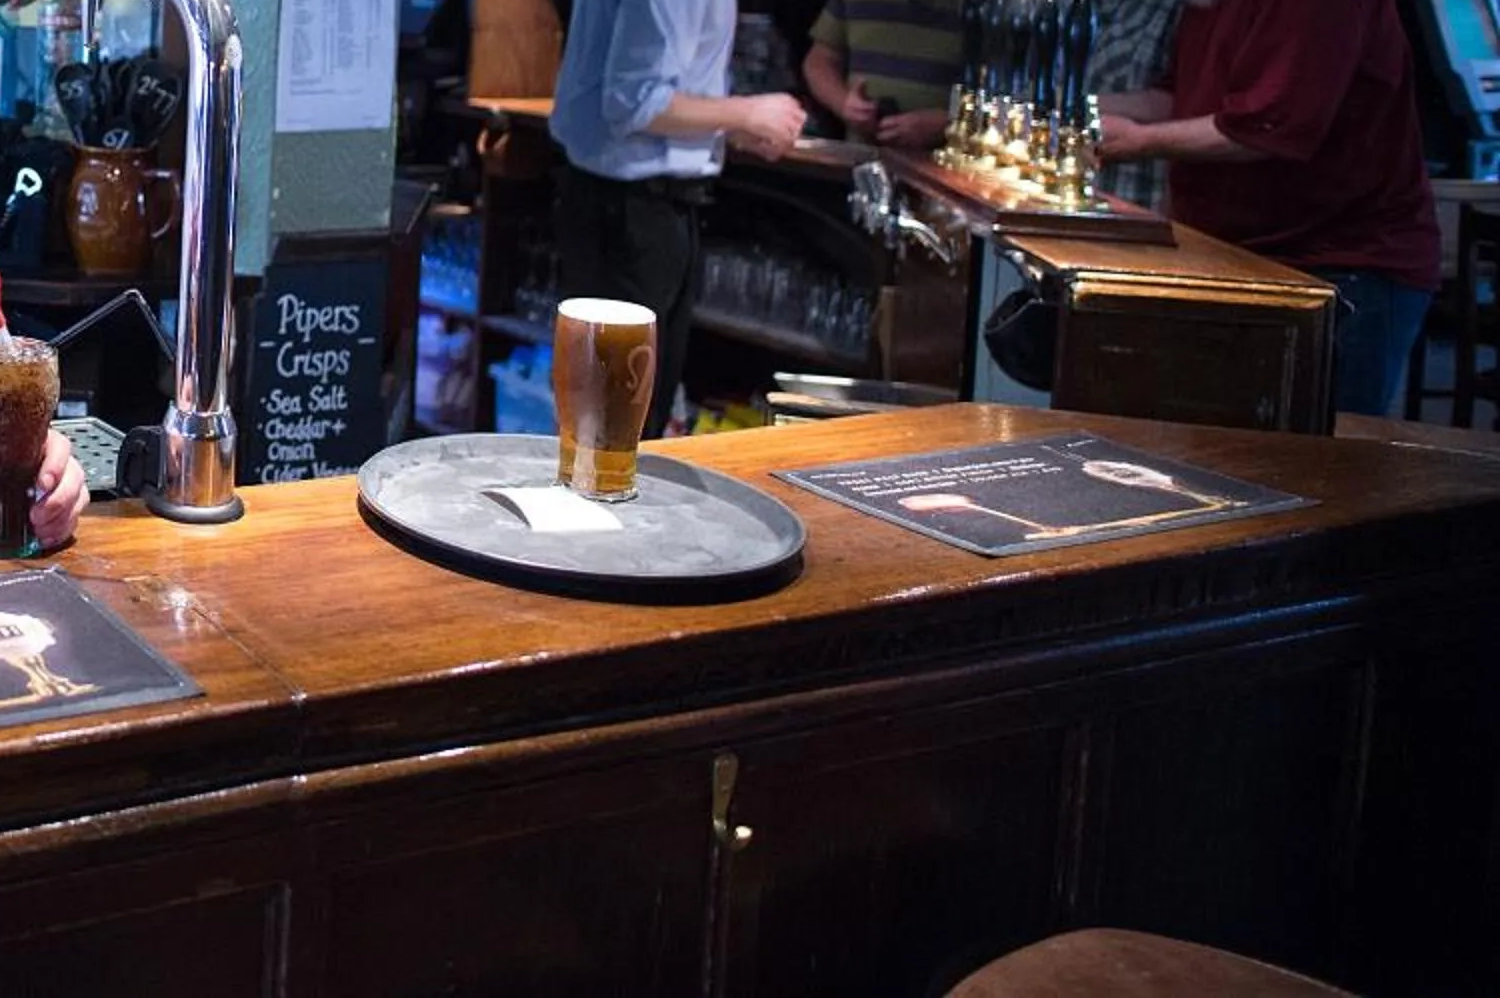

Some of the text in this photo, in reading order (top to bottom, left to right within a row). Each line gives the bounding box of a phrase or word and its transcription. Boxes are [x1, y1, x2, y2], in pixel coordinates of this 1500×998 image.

[277, 293, 360, 343] Pipers
[276, 341, 350, 384] Crisps
[266, 385, 348, 414] Sea Salt
[264, 415, 330, 440] Cheddar
[268, 442, 315, 461] Onion
